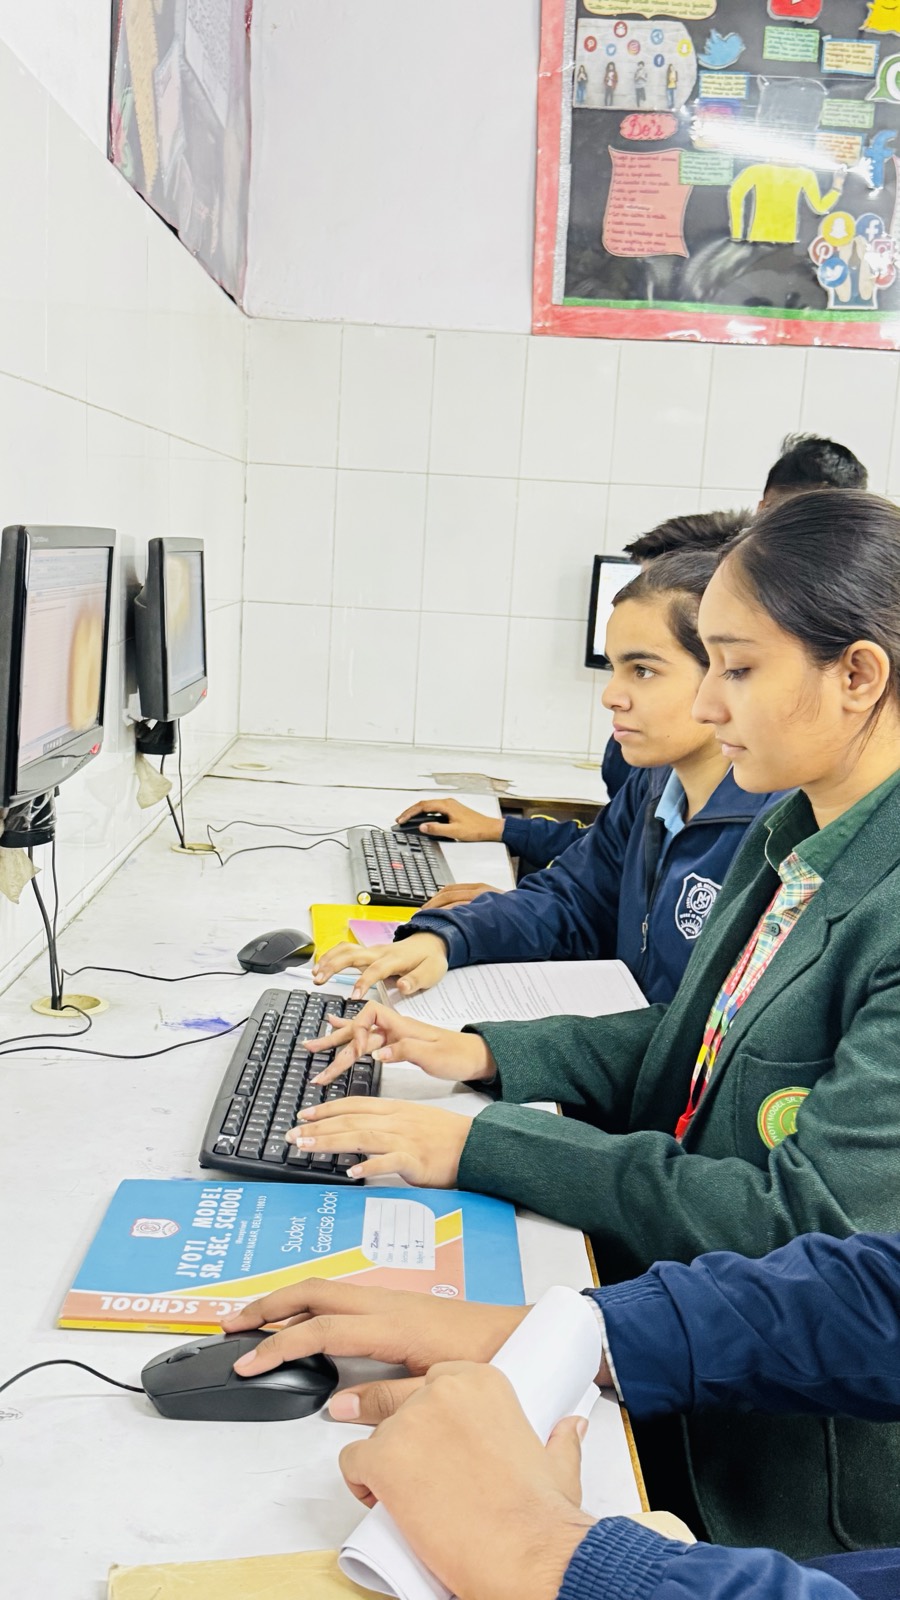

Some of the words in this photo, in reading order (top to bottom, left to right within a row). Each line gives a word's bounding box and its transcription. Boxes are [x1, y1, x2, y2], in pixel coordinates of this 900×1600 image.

[767, 1100, 786, 1122] MODEL
[214, 1187, 244, 1230] SCHOOL
[317, 1191, 338, 1214] Book
[175, 1240, 207, 1278] JYOTI
[192, 1187, 223, 1228] MODEL
[206, 1232, 232, 1256] SEC.
[281, 1216, 307, 1253] Student
[311, 1216, 335, 1253] Exercise
[199, 1259, 225, 1279] SR.
[241, 1249, 255, 1272] ADARSH
[101, 1296, 200, 1314] SCHOOL
[208, 1301, 248, 1316] EC.
